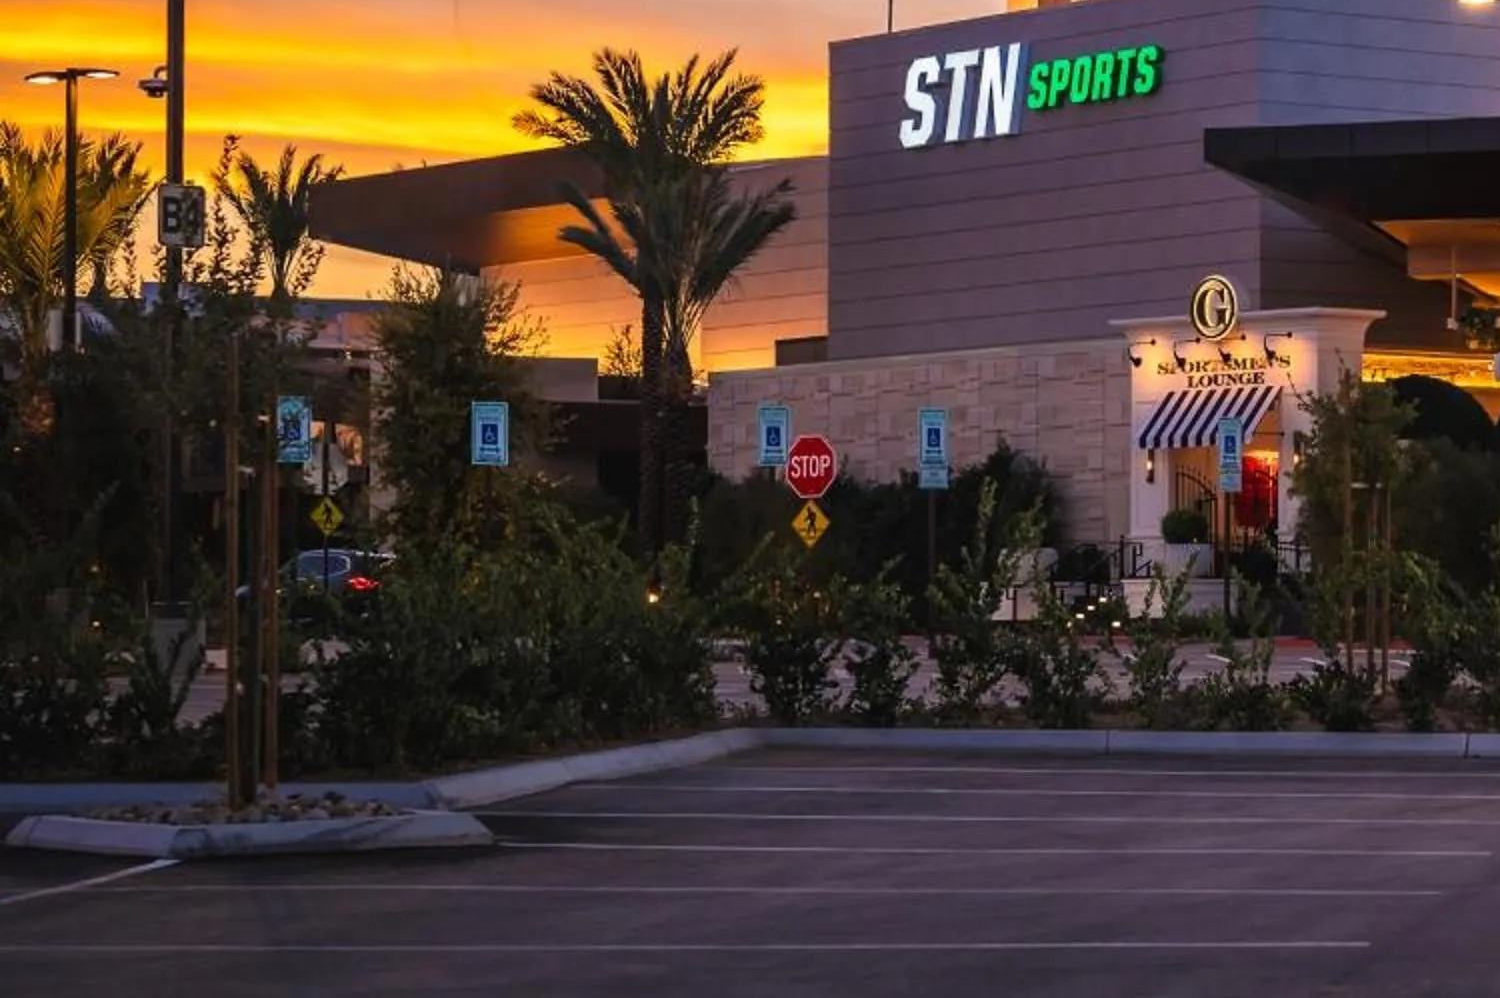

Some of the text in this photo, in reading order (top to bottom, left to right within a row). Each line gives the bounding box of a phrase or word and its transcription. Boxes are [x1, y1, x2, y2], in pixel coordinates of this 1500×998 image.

[899, 41, 1161, 149] STN SPORTS
[1156, 354, 1291, 375] SORTSME'S
[1186, 371, 1265, 388] LOUNGE
[791, 455, 831, 479] STOP
